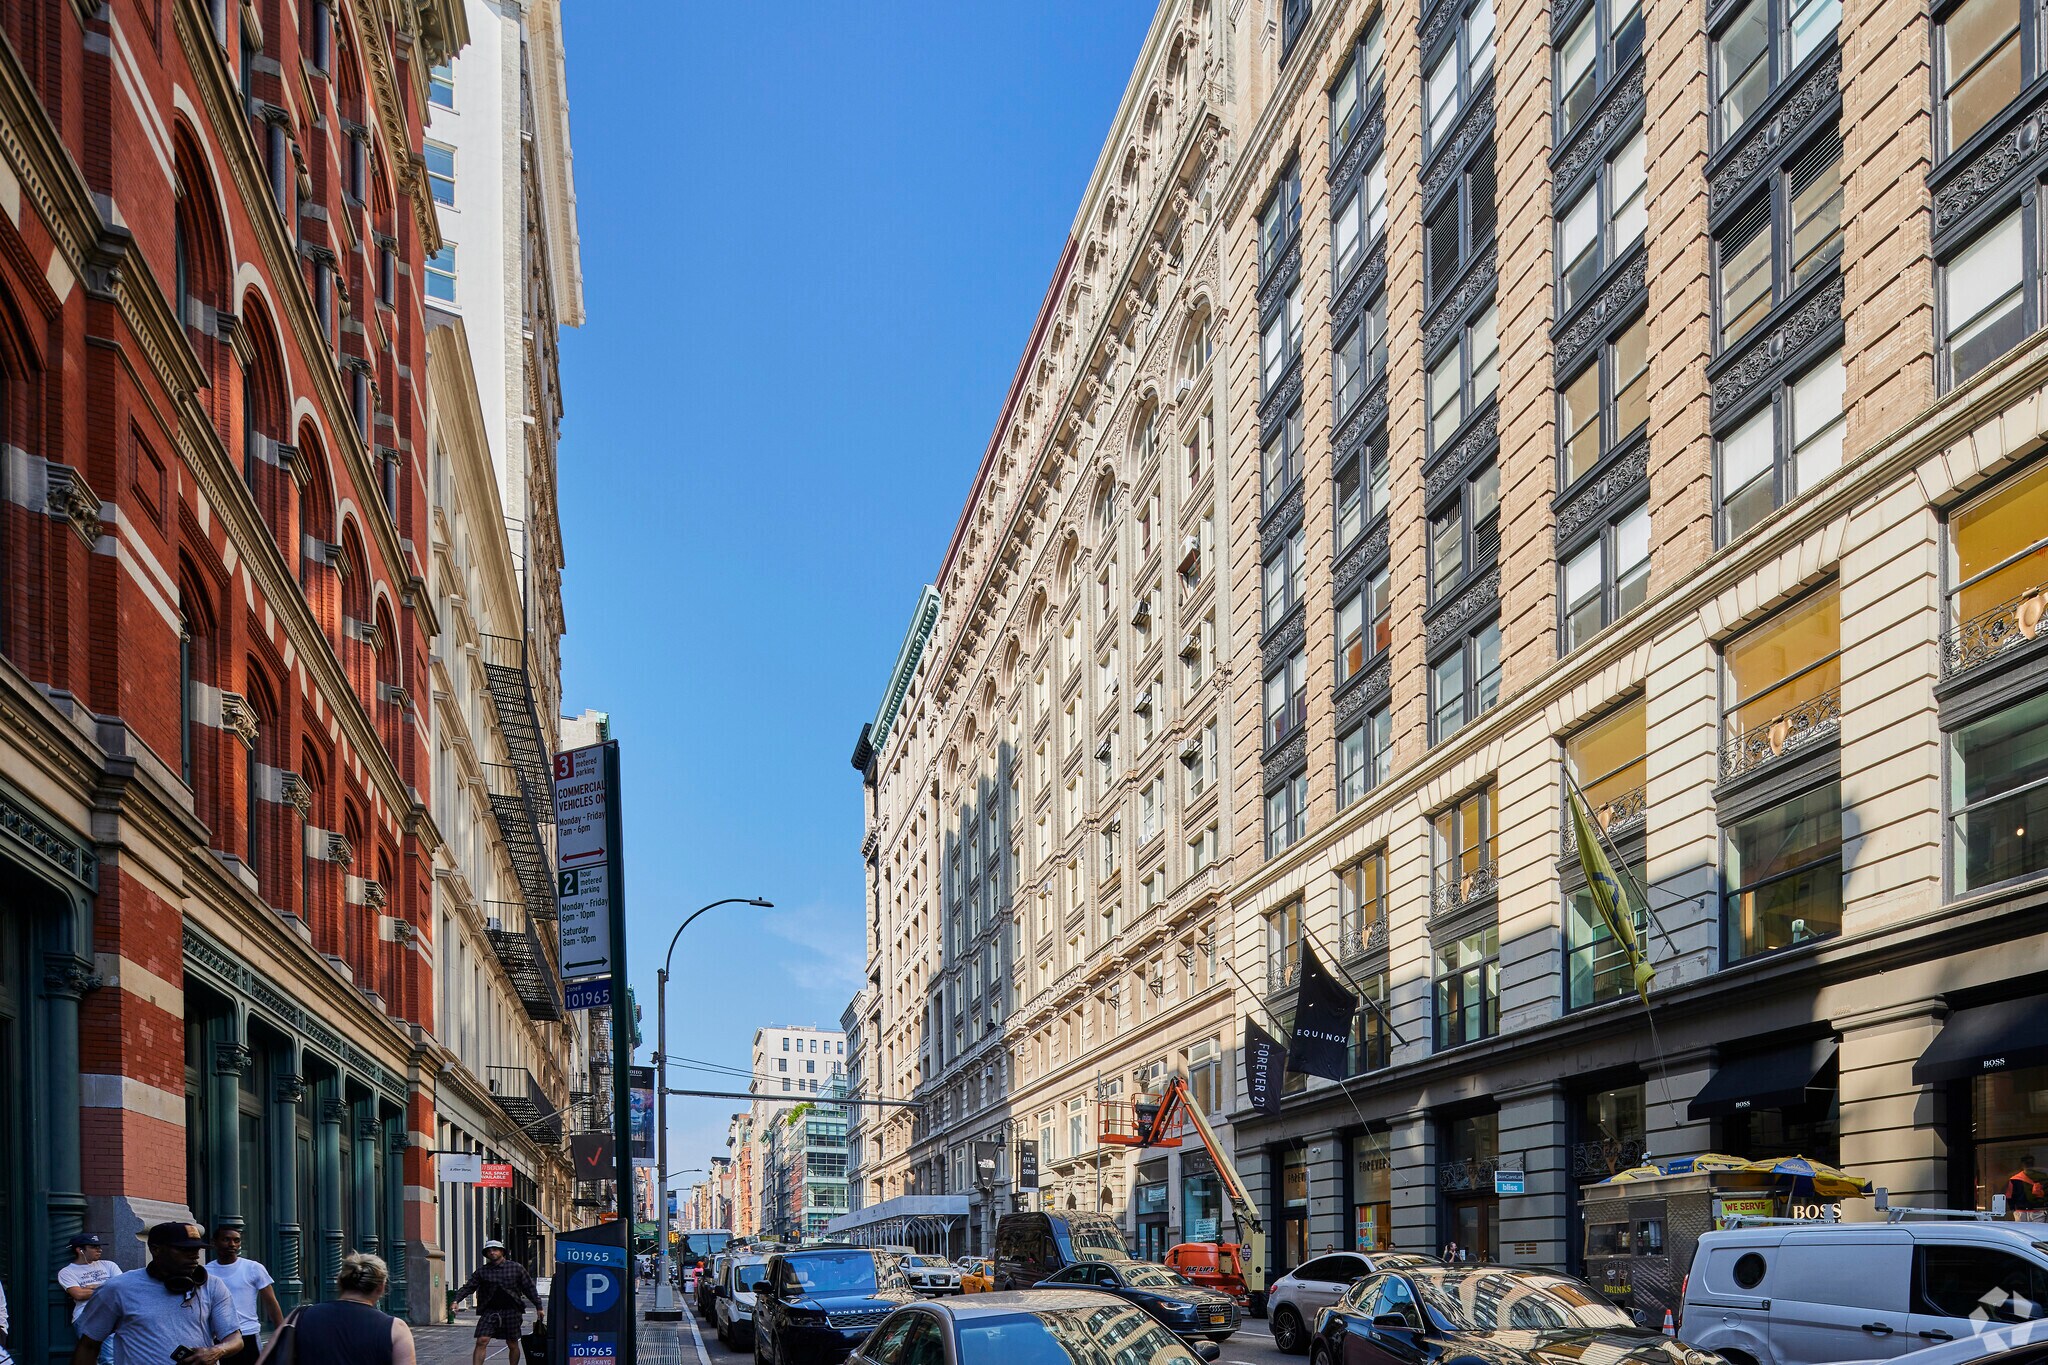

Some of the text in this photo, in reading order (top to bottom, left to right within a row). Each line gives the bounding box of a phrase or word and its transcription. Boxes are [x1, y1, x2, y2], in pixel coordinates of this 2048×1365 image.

[575, 751, 587, 759] hour
[559, 755, 570, 777] 3
[576, 757, 598, 768] metered
[576, 767, 595, 778] parking
[558, 780, 606, 800] COMMERCIAL
[559, 793, 606, 812] VEHICLES ON
[559, 815, 582, 827] Monday
[586, 811, 606, 821] Friday
[559, 828, 573, 837] 7am
[577, 824, 591, 835] 6pm
[580, 870, 592, 878] hour
[563, 873, 574, 895] 2
[580, 876, 603, 886] metered
[580, 885, 600, 896] parking
[561, 901, 585, 912] Monday
[590, 897, 609, 907] Friday
[562, 914, 575, 923] 6pm
[580, 910, 596, 920] 10pm
[562, 925, 589, 937] Saturday
[562, 938, 576, 947] 8am
[580, 935, 597, 945] 10pm
[566, 989, 610, 1008] 101965
[1296, 1029, 1347, 1044] EQUINOX
[1984, 1058, 2005, 1067] BOSS
[1253, 1043, 1270, 1108] FOREVER 21
[1502, 1183, 1518, 1191] bliss
[1725, 1201, 1766, 1211] WE SERVE
[567, 1250, 610, 1262] 101965
[586, 1273, 610, 1307] P
[1603, 1284, 1632, 1294] DRINKS
[573, 1347, 613, 1357] 101965
